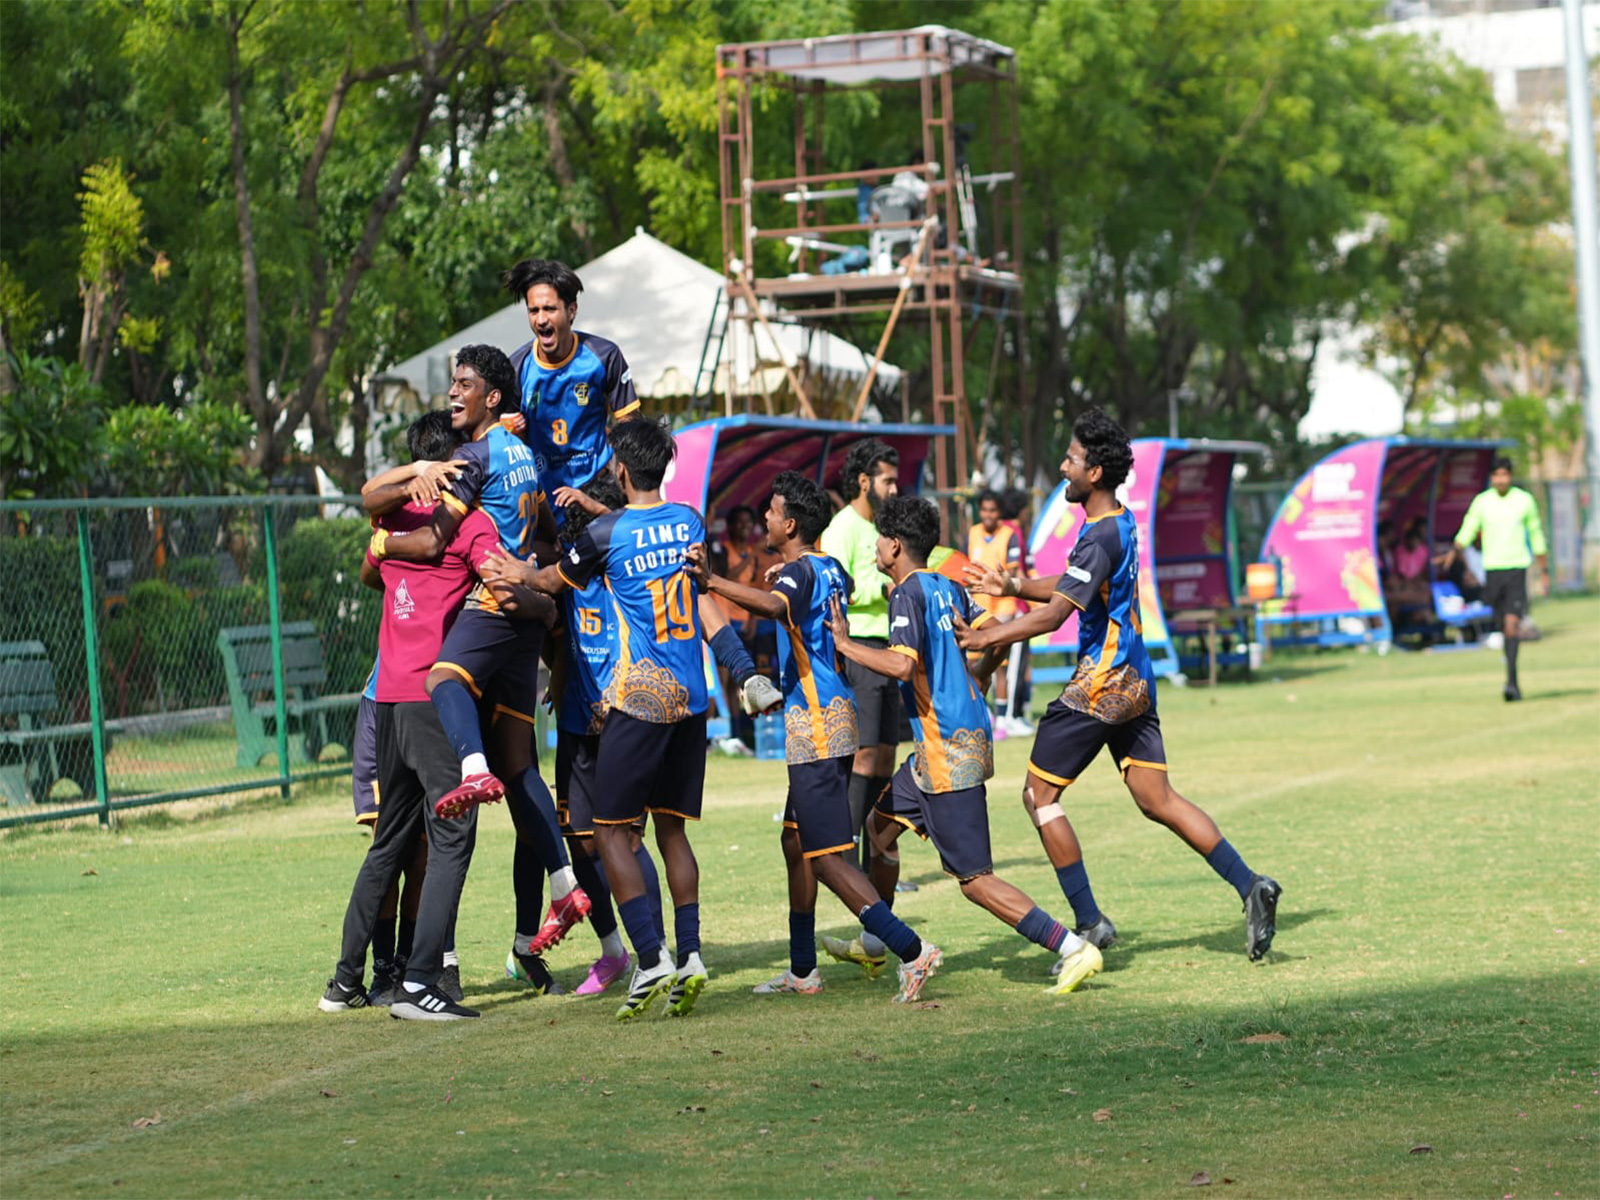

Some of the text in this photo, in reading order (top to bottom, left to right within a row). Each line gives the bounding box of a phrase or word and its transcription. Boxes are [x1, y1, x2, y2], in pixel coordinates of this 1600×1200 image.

[551, 418, 568, 446] 8
[503, 444, 532, 465] ZINC
[631, 523, 690, 549] ZINC
[578, 607, 601, 635] 15
[645, 571, 695, 644] 19
